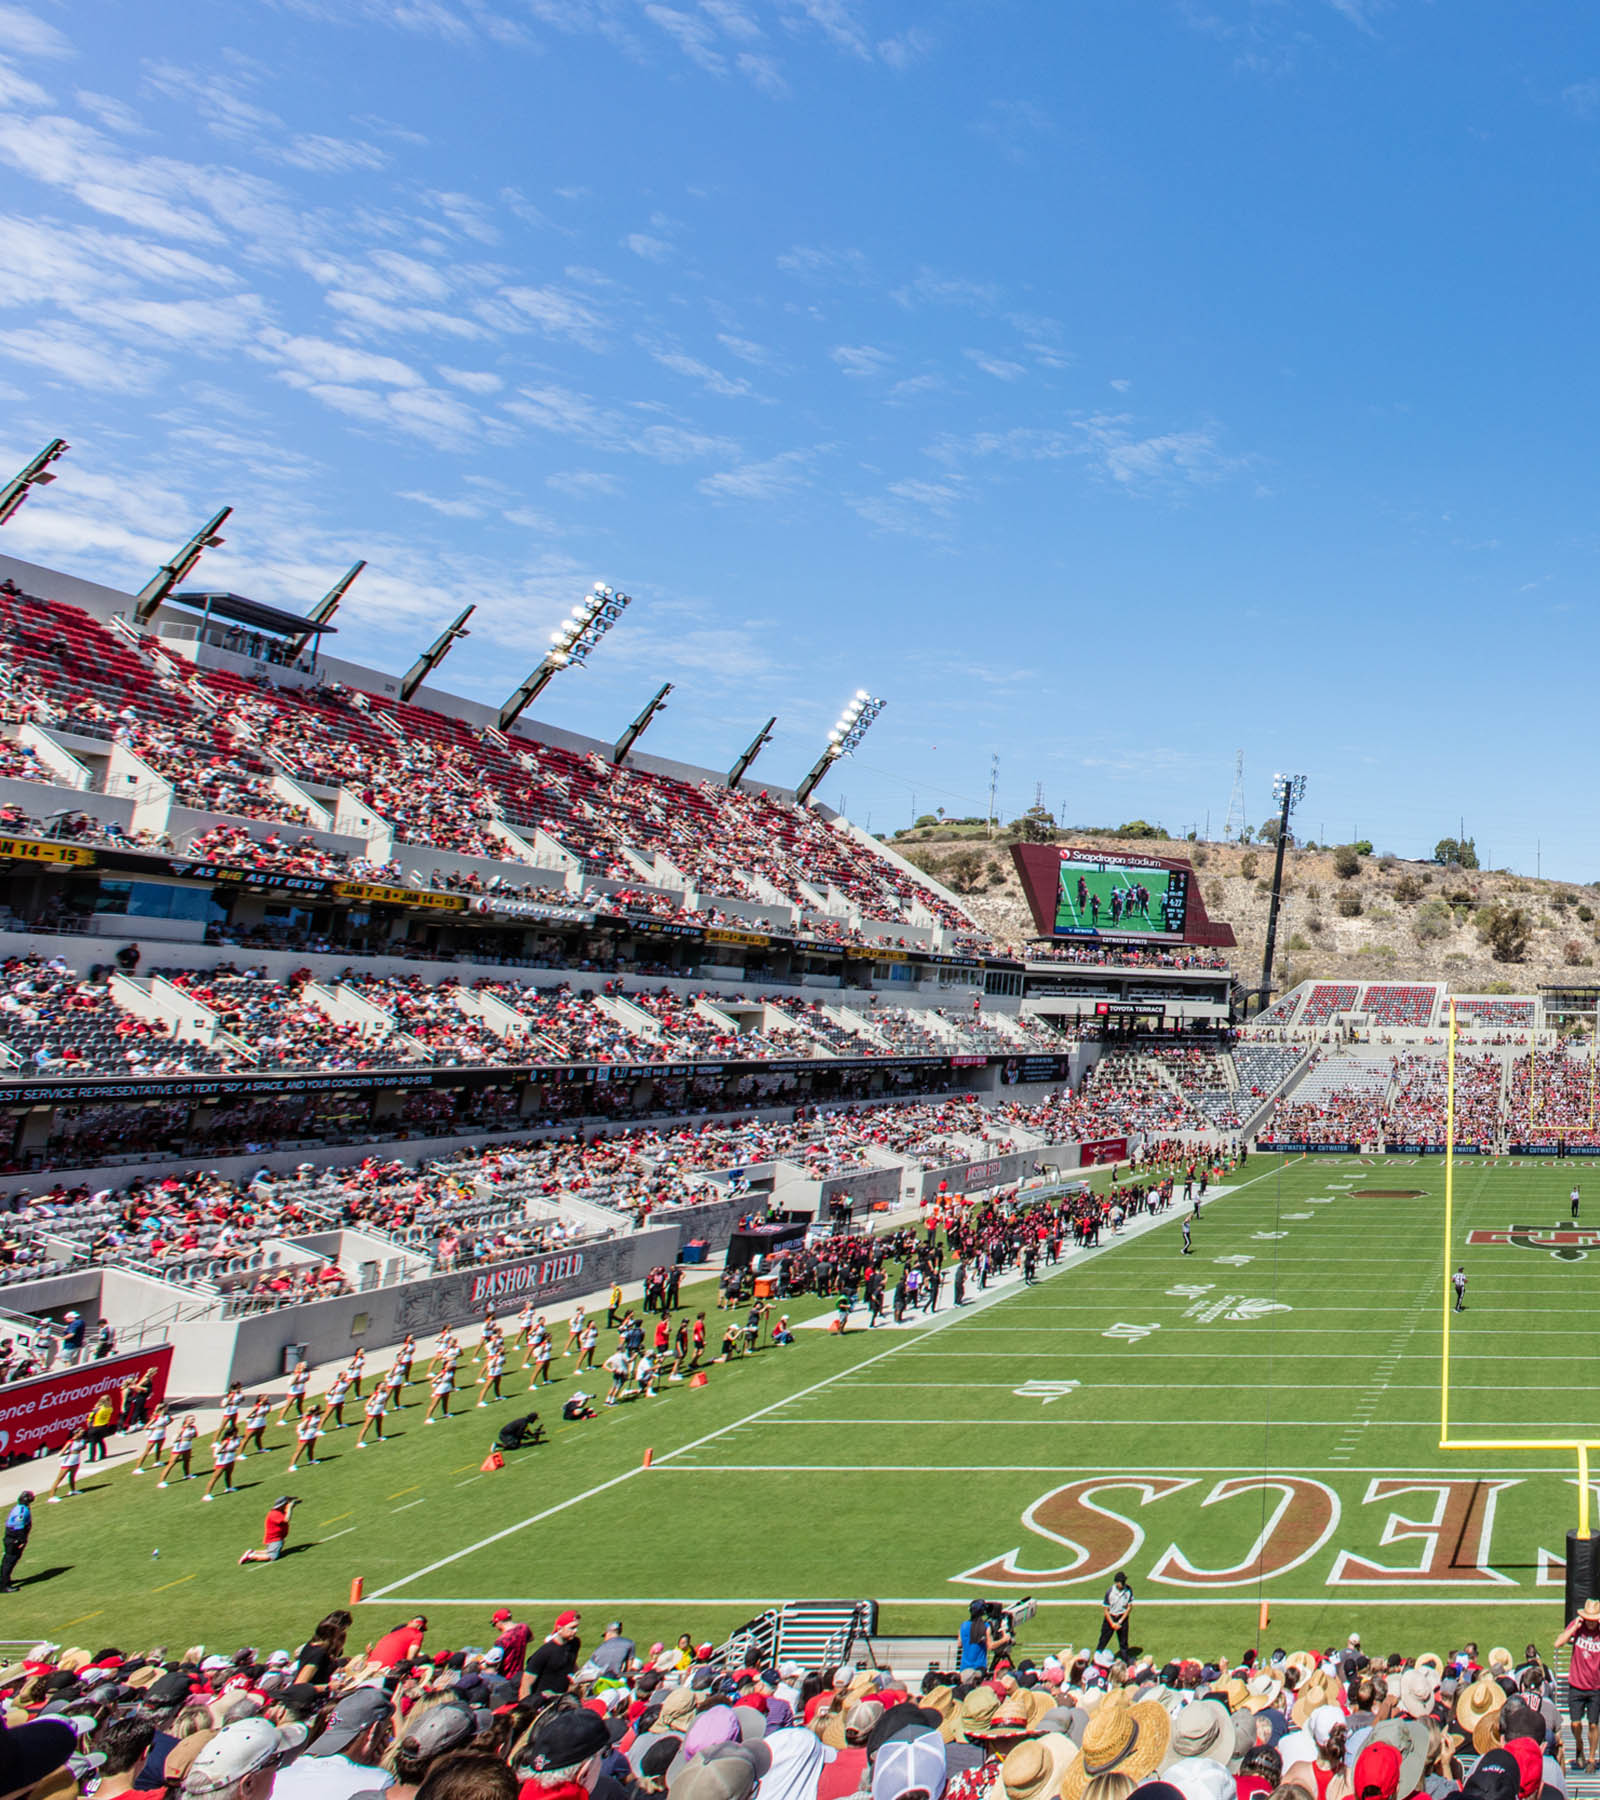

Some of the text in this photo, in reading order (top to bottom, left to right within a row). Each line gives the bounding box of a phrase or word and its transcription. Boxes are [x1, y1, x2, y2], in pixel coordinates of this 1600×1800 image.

[20, 844, 40, 857] 14
[59, 848, 78, 862] 15
[1072, 851, 1161, 868] Snapdragon stadium
[193, 867, 325, 890] AS BIG AS IT GETS!
[342, 885, 363, 896] JAN
[22, 1088, 77, 1100] SERVICE
[77, 1084, 174, 1098] REPRESENTATIVE
[175, 1084, 192, 1094] OR
[193, 1083, 220, 1093] TEXT
[244, 1082, 252, 1090] A
[286, 1080, 305, 1089] AND
[306, 1079, 331, 1088] YOUR
[332, 1078, 373, 1088] CONCERN
[373, 1077, 384, 1086] TO
[471, 1253, 584, 1302] BASHOR FIELD
[497, 1291, 539, 1309] Snapdragon
